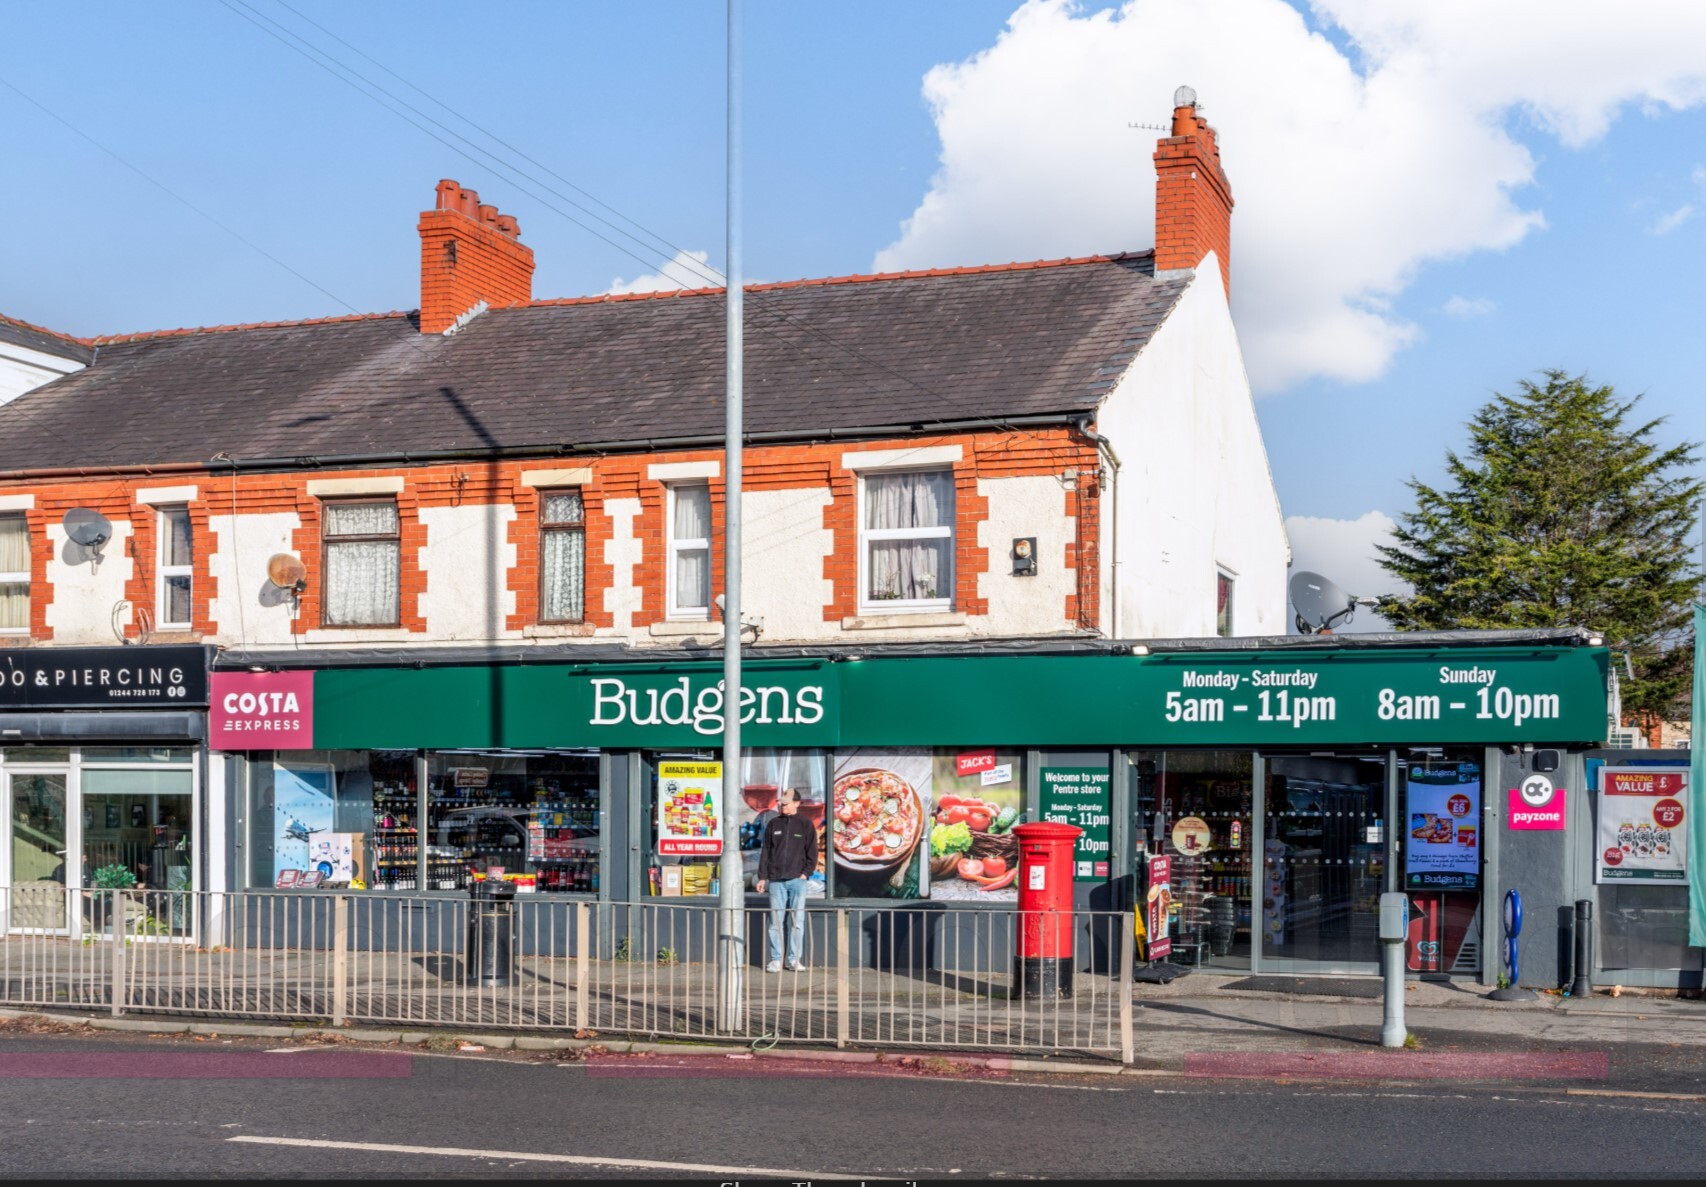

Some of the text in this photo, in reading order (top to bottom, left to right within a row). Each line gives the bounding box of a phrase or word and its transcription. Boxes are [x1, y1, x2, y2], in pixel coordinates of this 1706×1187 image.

[35, 669, 49, 686] &
[56, 668, 183, 686] PIERCING
[1183, 670, 1240, 691] Monday
[1252, 669, 1318, 690] Saturday
[1440, 666, 1497, 687] Sunday
[108, 689, 131, 697] 01244
[223, 692, 300, 717] COSTA
[589, 676, 824, 735] Budgens
[1165, 691, 1225, 722] 5am
[1258, 690, 1337, 728] 11pm
[1378, 688, 1440, 720] 8am
[1476, 687, 1560, 726] 10pm
[234, 720, 300, 731] EXPRESS
[960, 755, 993, 769] JACK'S
[664, 766, 717, 774] AMAZING VALUE
[1045, 773, 1109, 784] Welcome to your
[1615, 774, 1653, 782] AMAZING
[1053, 784, 1102, 794] Pentre store
[1615, 782, 1654, 792] VALUE
[1051, 804, 1073, 812] Monday
[1077, 804, 1102, 813] Saturday
[1452, 803, 1466, 813] £6
[1045, 812, 1067, 824] 5am
[1079, 812, 1109, 828] 11pm
[1513, 812, 1560, 824] payzone
[1663, 812, 1675, 821] £2
[1079, 838, 1109, 854] 10pm
[1424, 875, 1463, 885] Budgens
